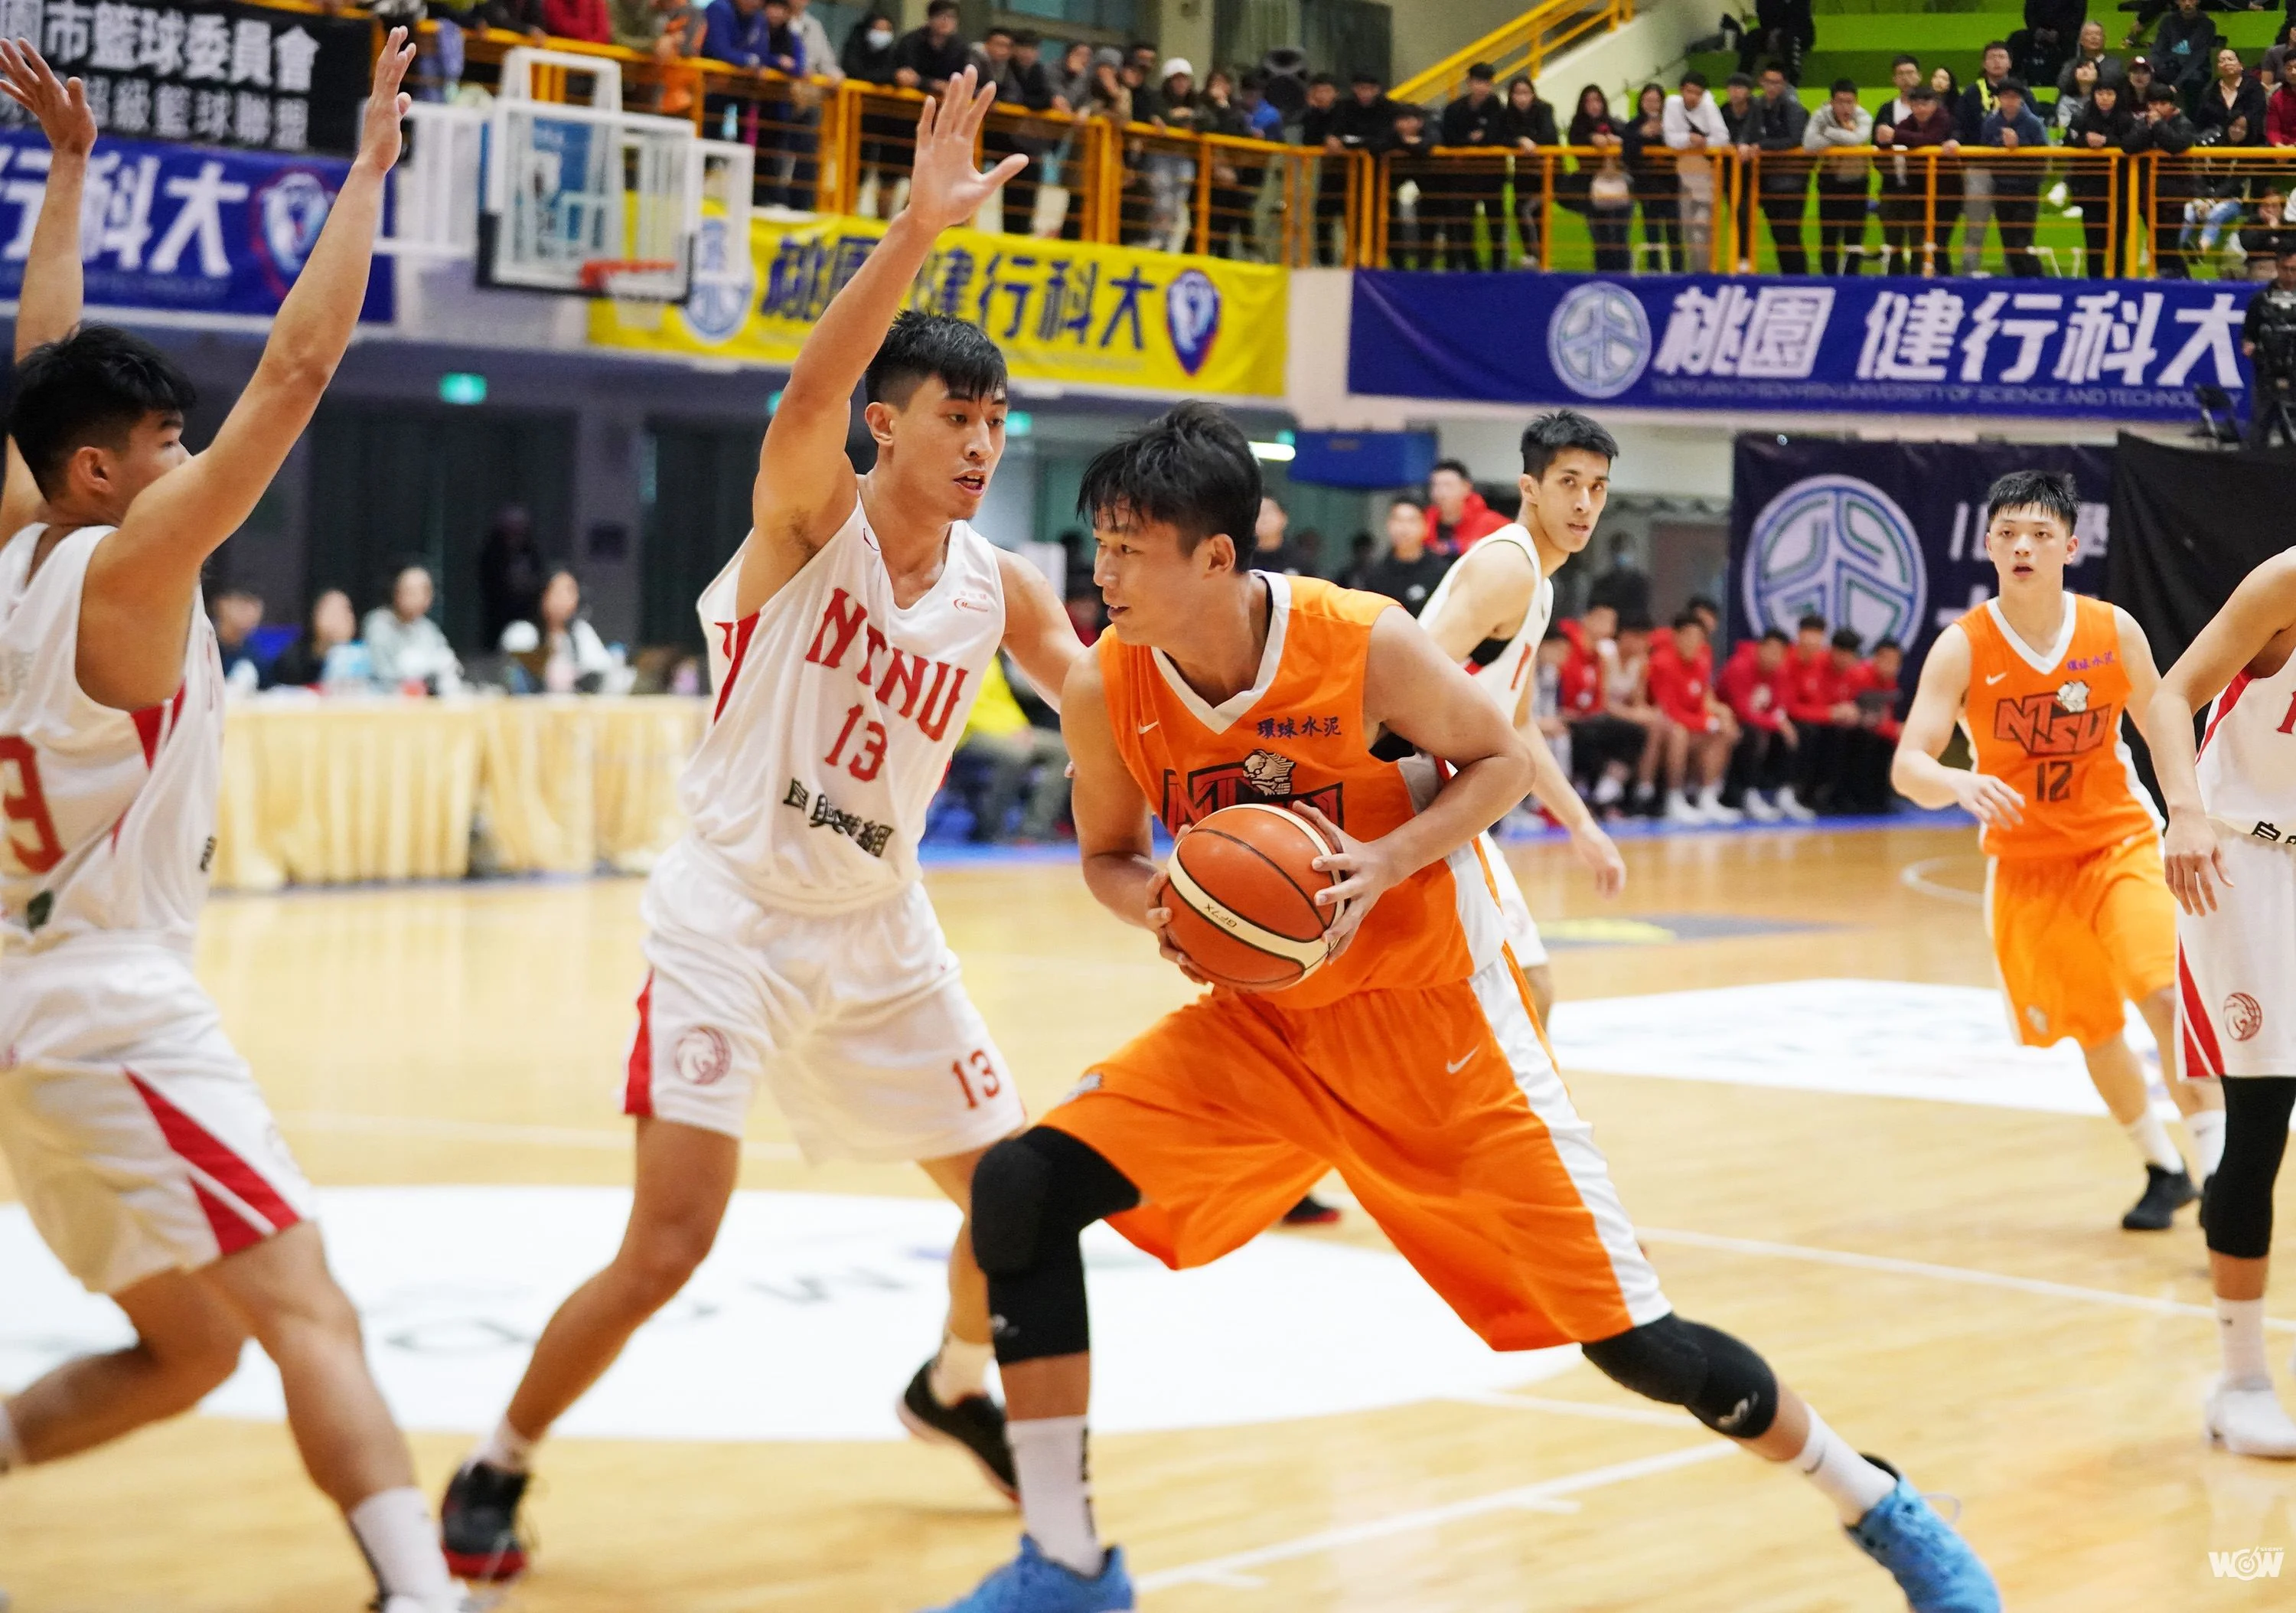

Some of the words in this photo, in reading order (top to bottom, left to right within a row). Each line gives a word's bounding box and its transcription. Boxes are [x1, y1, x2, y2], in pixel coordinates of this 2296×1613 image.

[1652, 285, 1837, 378] 桃園
[1855, 288, 2246, 388] 健行科大
[2066, 387, 2107, 406] AND
[805, 588, 969, 743] NTNU
[825, 704, 888, 782] 13
[1257, 716, 1342, 740] 環球水泥
[1994, 691, 2112, 756] NTSU
[2037, 761, 2073, 802] 12
[951, 1049, 1000, 1109] 13
